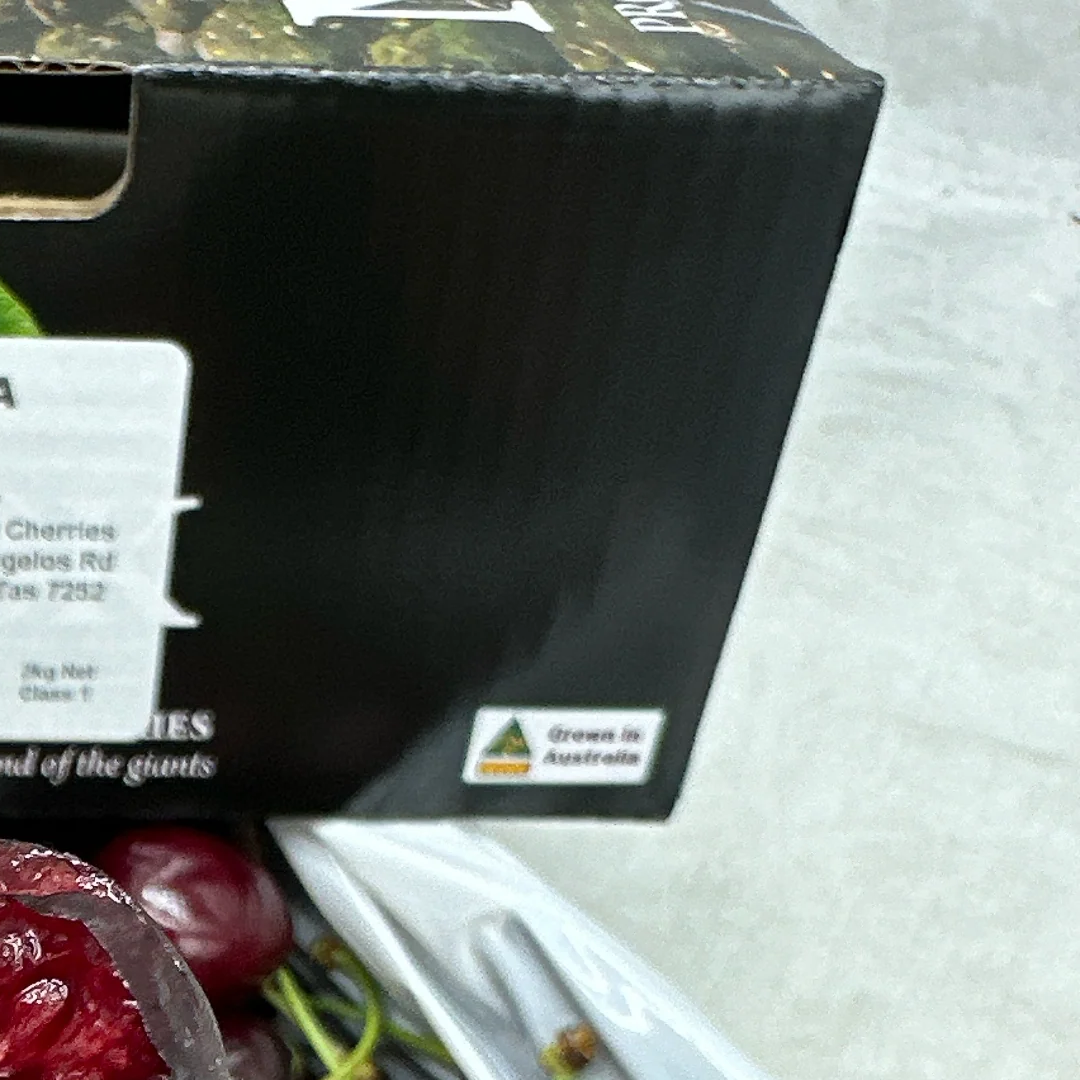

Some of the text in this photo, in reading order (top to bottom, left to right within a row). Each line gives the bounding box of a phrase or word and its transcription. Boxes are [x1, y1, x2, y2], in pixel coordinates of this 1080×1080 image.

[5, 517, 117, 542] Cherries
[79, 551, 116, 572] Rd
[548, 725, 640, 743] Grown in
[40, 744, 76, 786] of
[76, 746, 122, 778] the
[123, 750, 217, 787] giants
[543, 749, 640, 766] Australia
